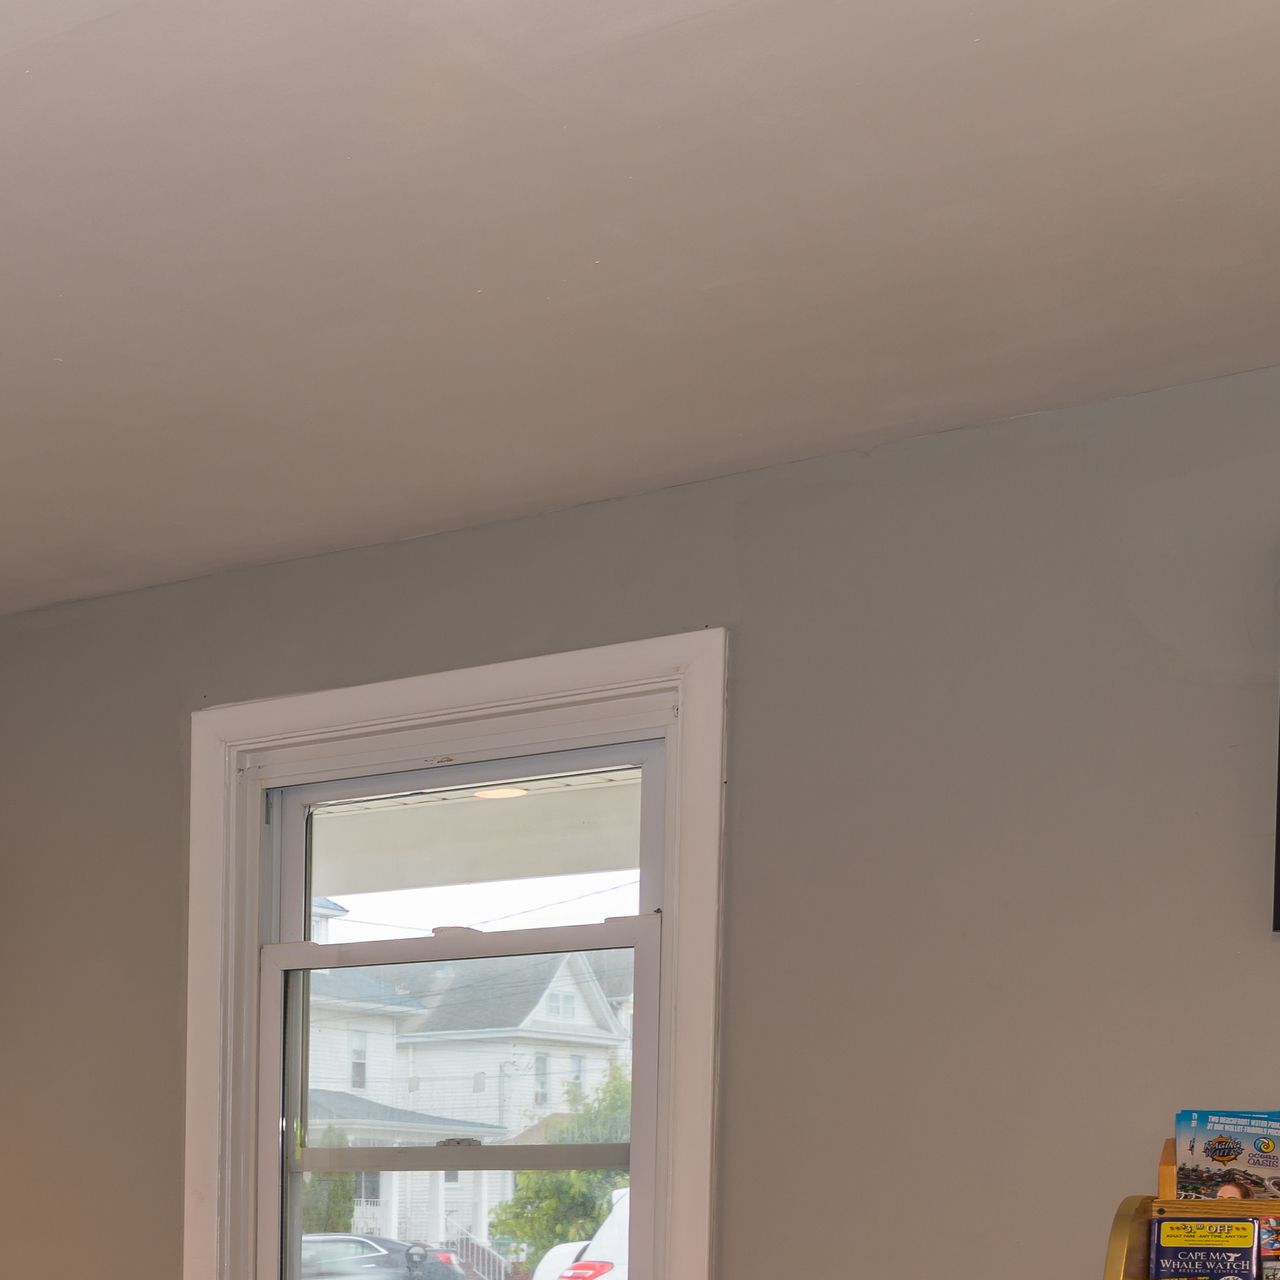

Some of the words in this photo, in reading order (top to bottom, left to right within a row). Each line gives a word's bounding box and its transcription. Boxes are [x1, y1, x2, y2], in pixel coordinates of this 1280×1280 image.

[1247, 1158, 1279, 1168] OASIS
[1206, 1224, 1233, 1234] OFF
[1178, 1251, 1207, 1260] CAPE
[1160, 1260, 1203, 1269] WHALE
[1205, 1260, 1250, 1270] WATCH
